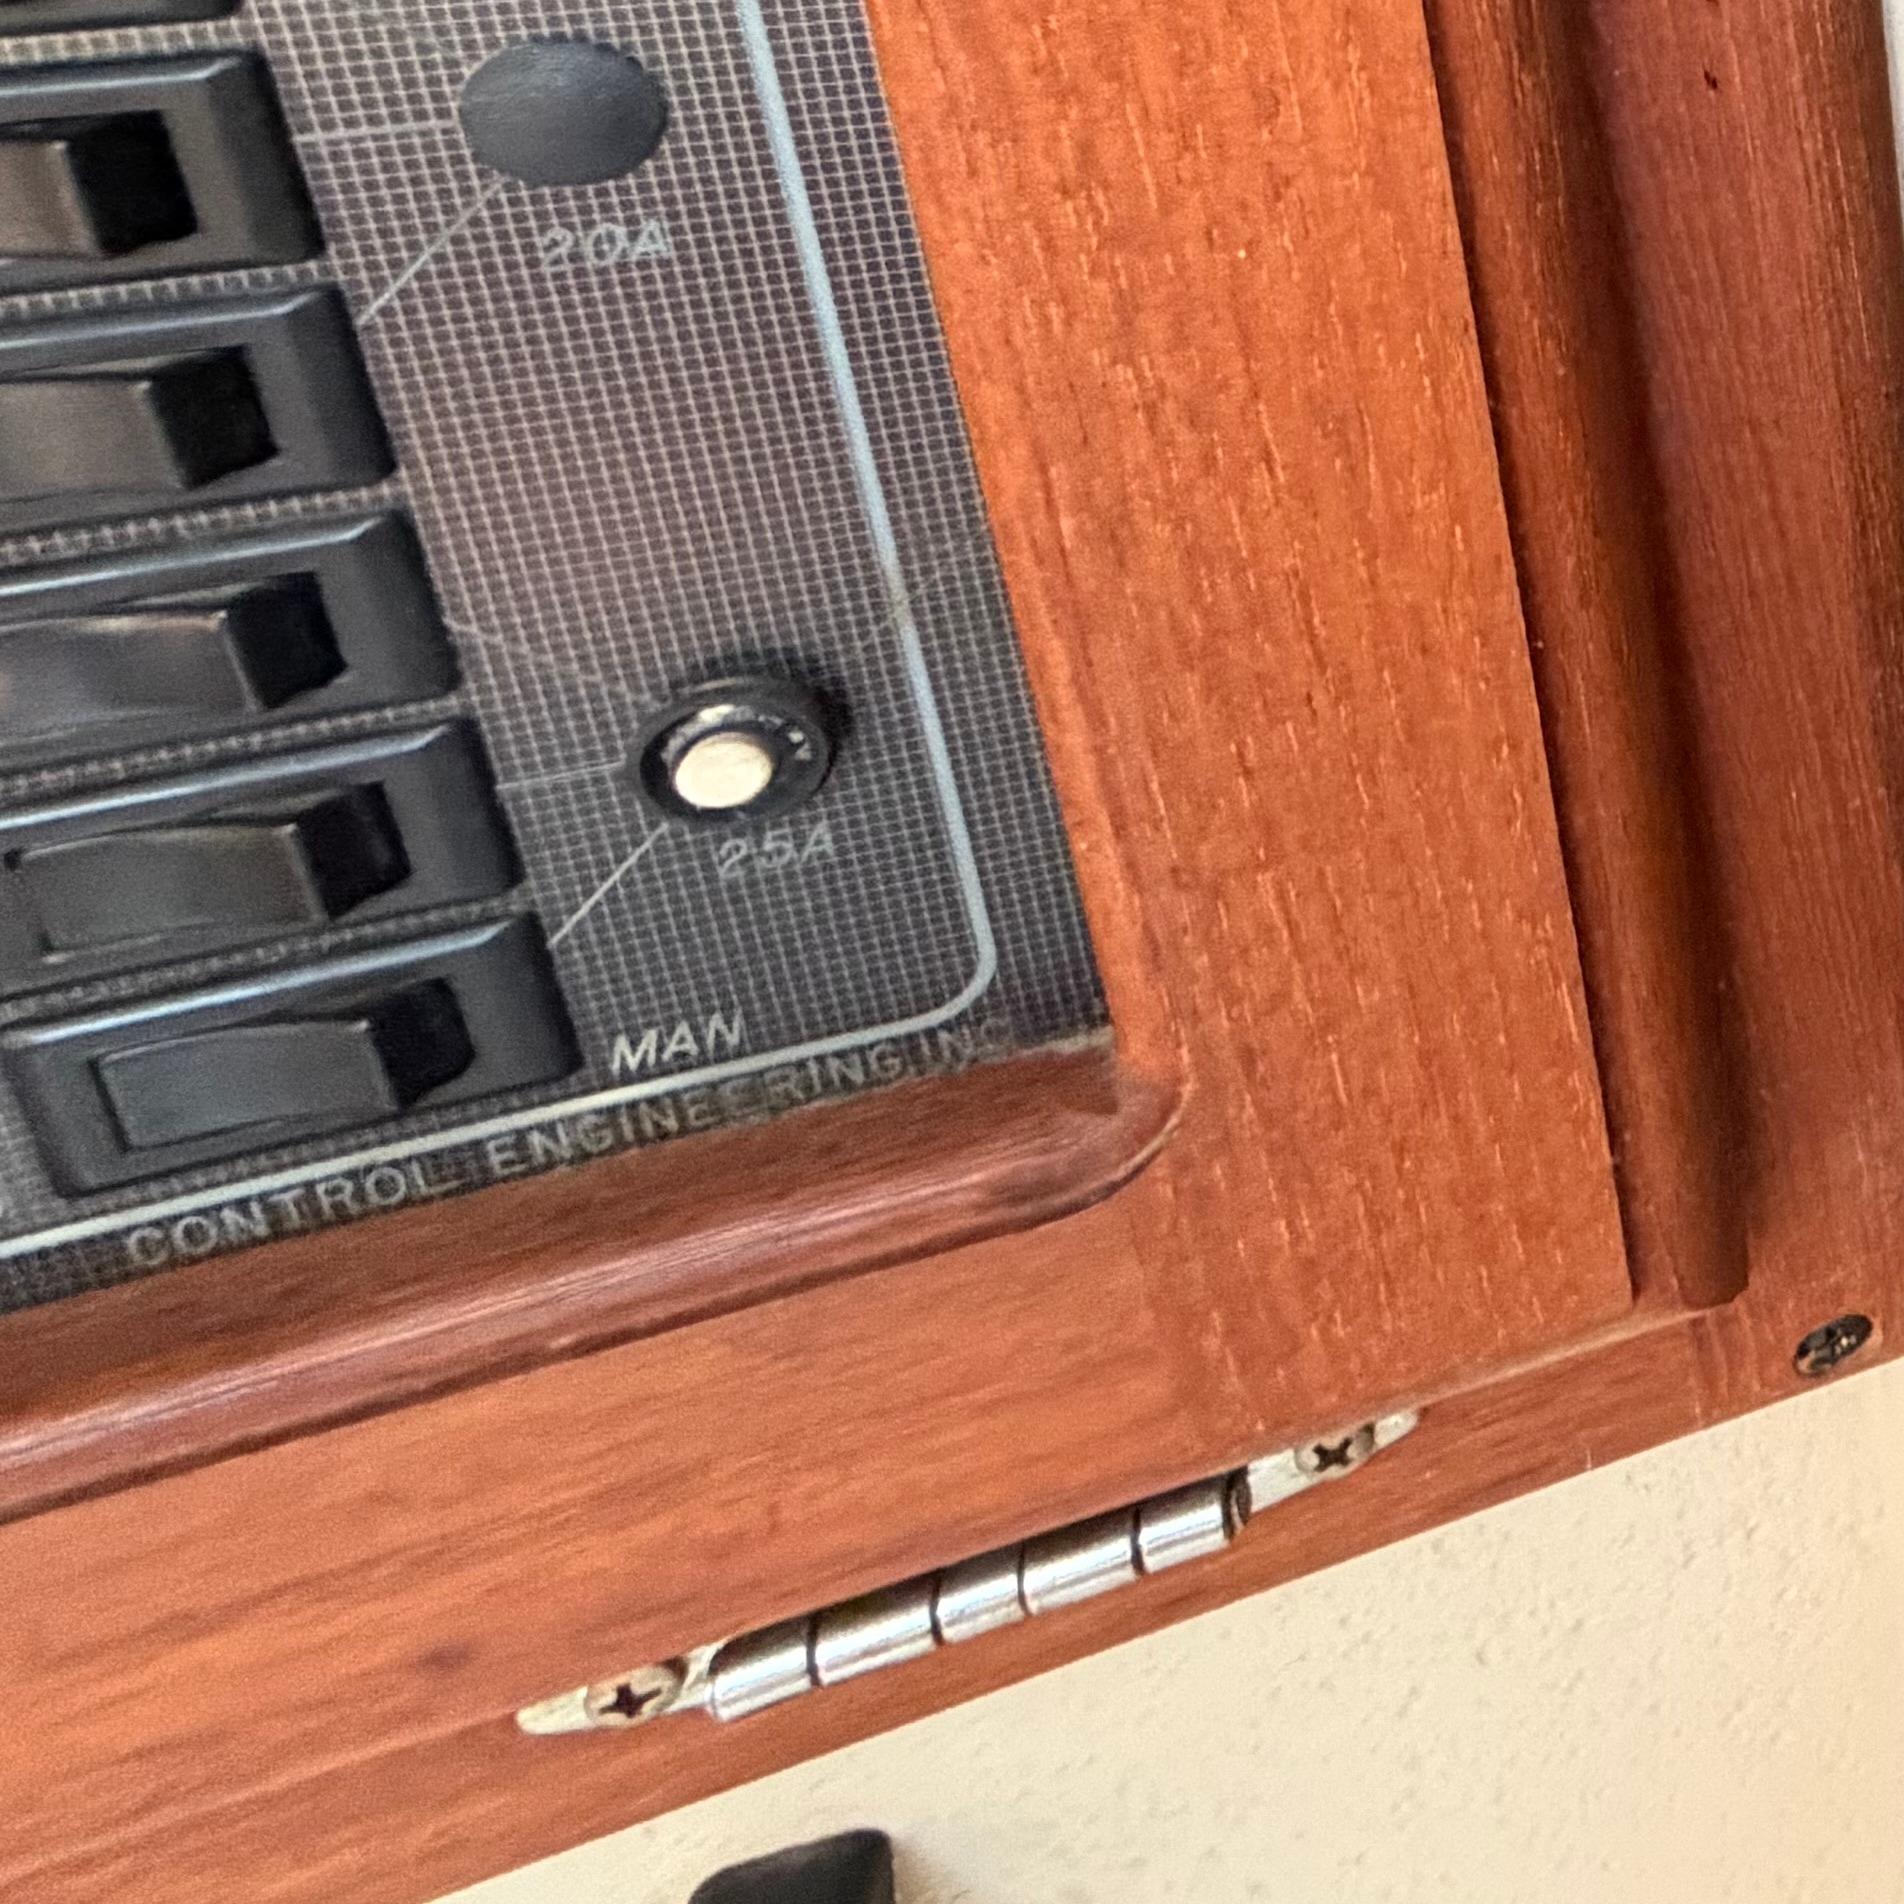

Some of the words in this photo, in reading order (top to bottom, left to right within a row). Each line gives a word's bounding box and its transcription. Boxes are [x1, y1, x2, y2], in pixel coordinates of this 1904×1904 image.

[542, 220, 674, 271] 20A
[718, 821, 835, 878] 25A
[612, 1008, 746, 1076] MAN
[126, 1162, 450, 1268] CONTROL
[484, 1040, 902, 1179] ENGINEERING
